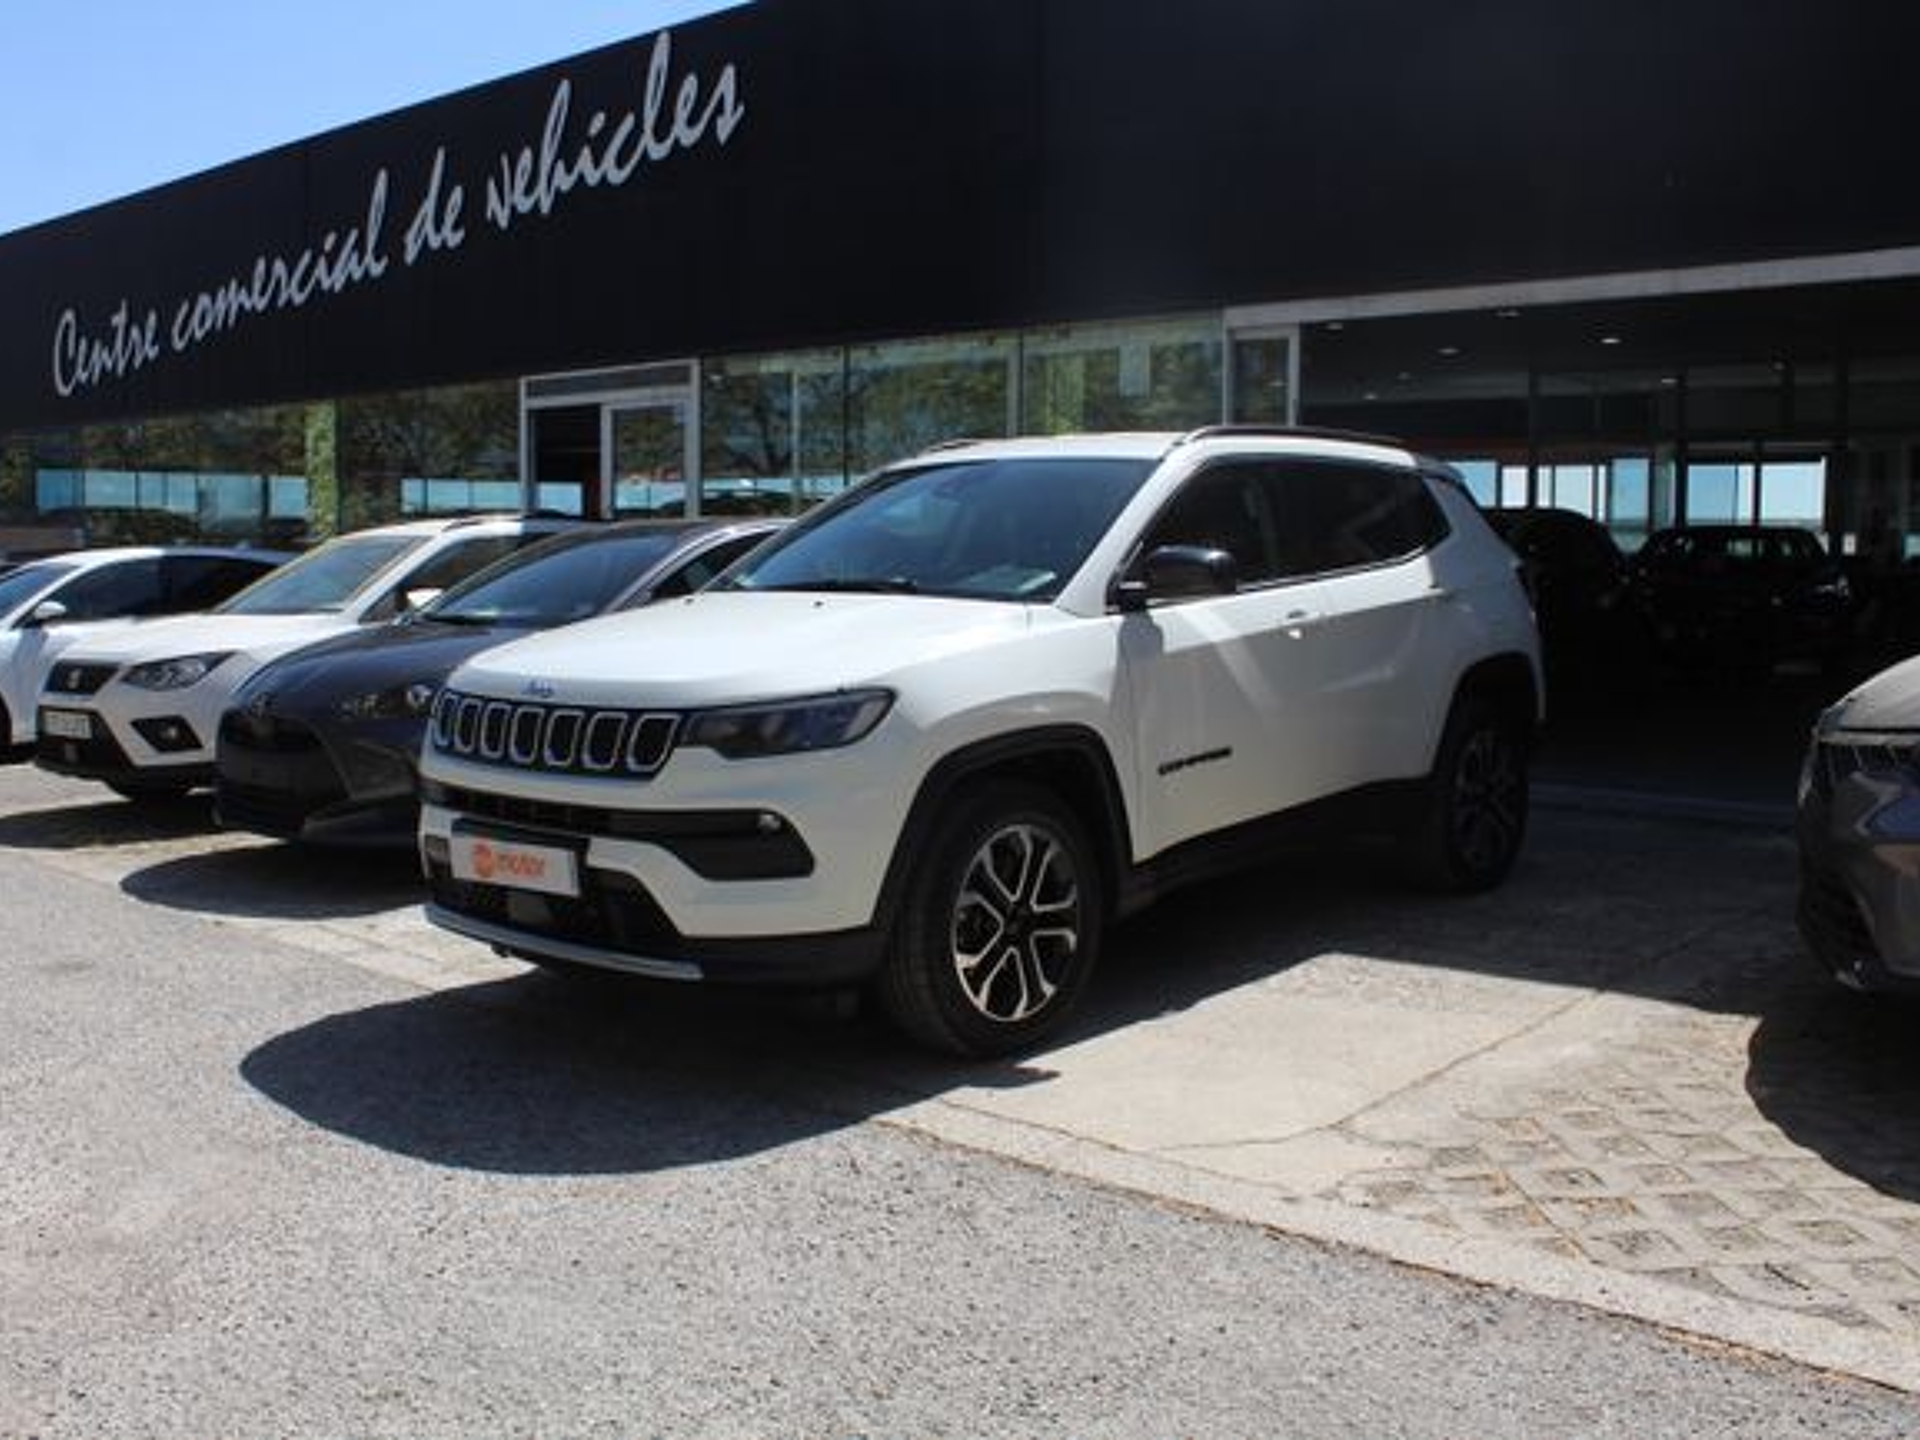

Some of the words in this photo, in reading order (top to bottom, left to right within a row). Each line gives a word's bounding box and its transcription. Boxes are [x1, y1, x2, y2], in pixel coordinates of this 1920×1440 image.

[54, 300, 159, 396] Centre
[172, 169, 388, 351] comercial
[404, 147, 465, 265] de
[486, 31, 745, 229] vehicles
